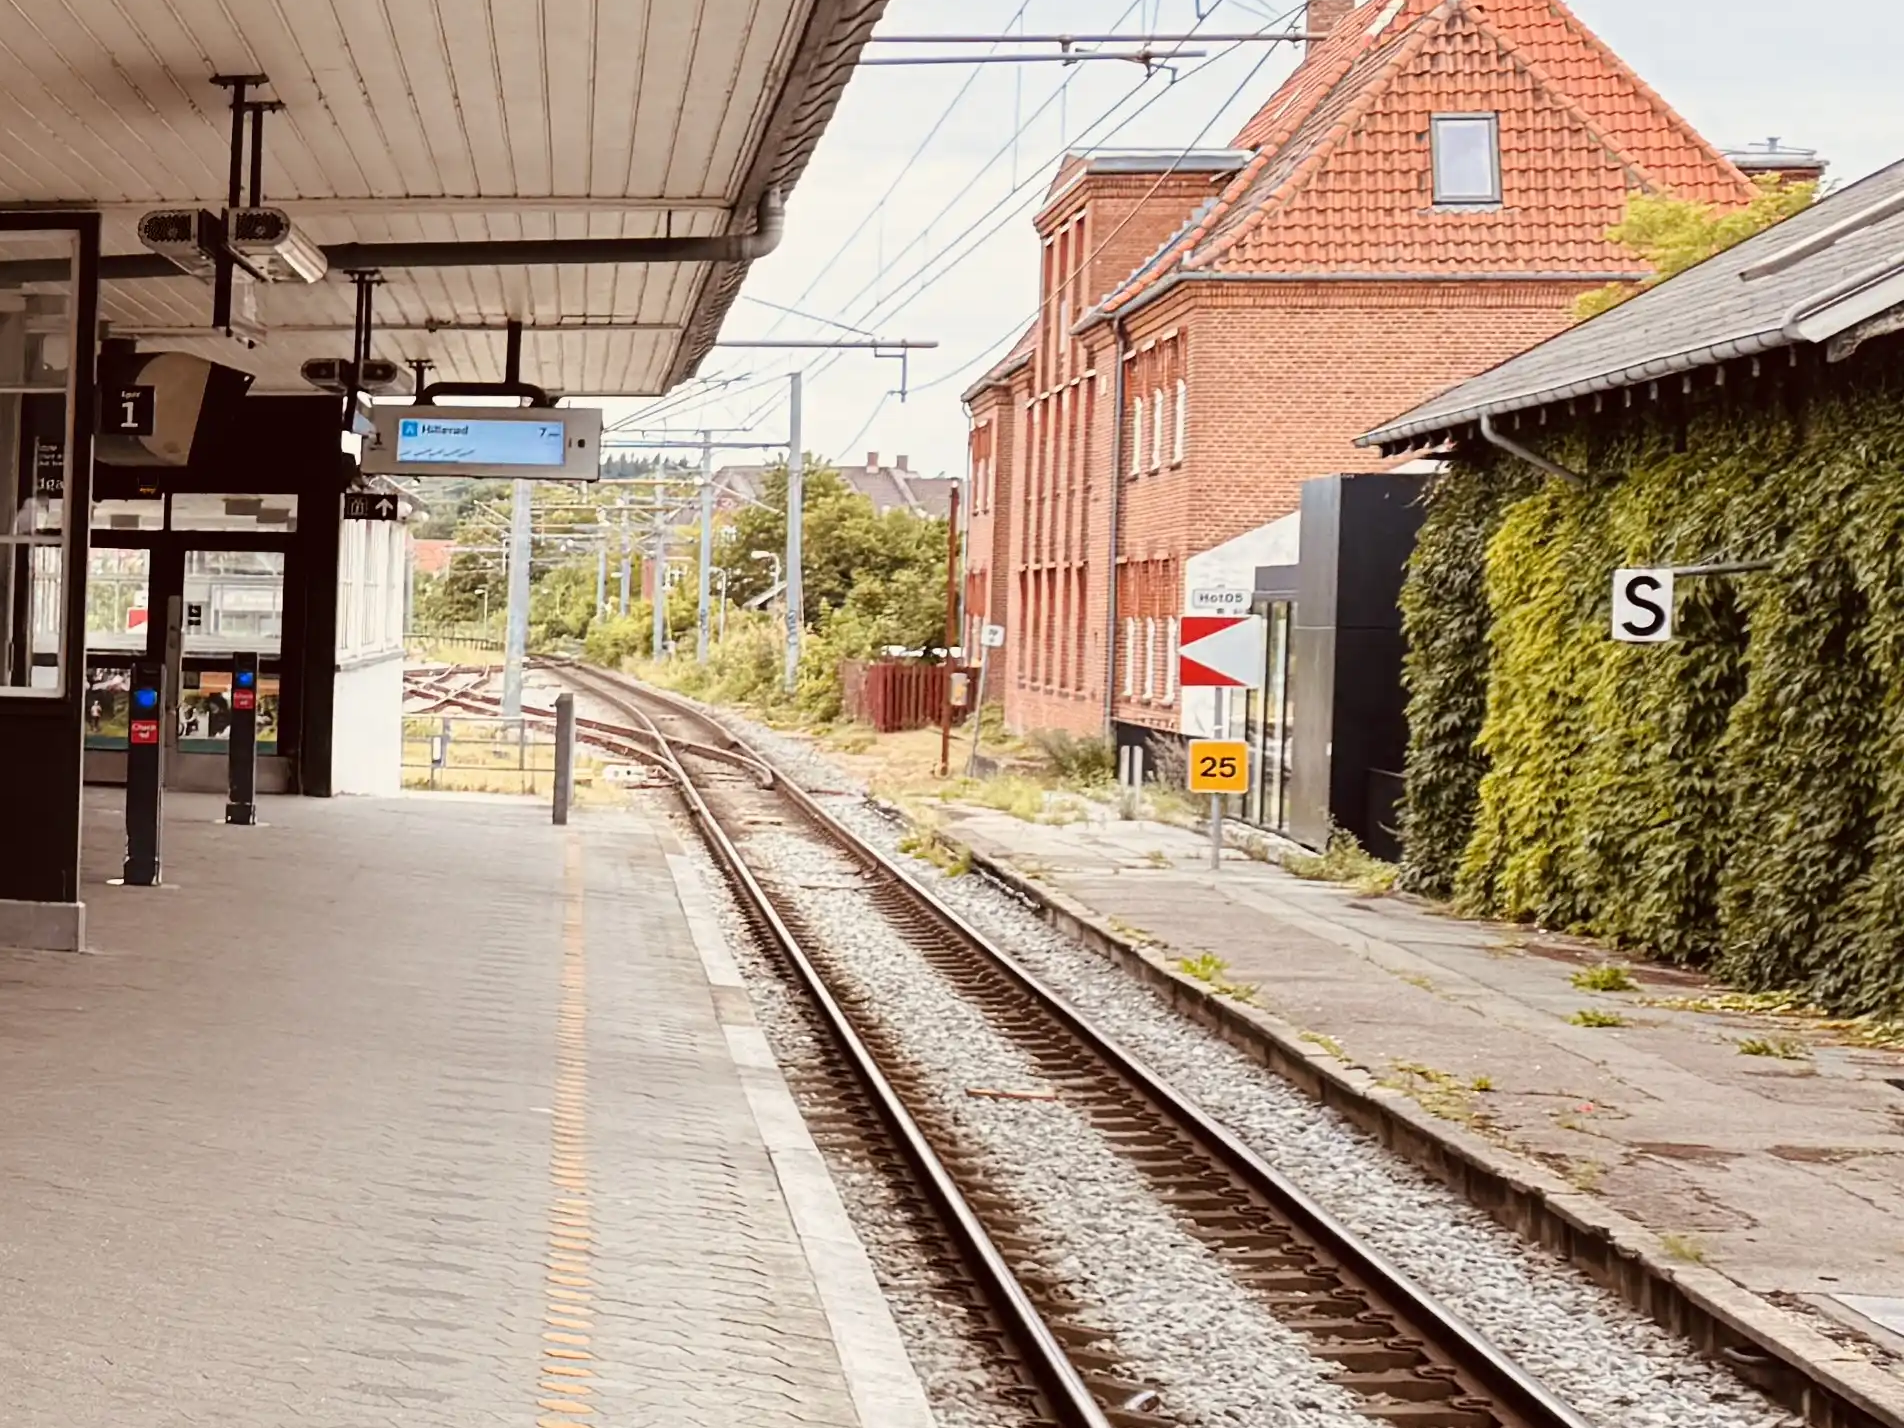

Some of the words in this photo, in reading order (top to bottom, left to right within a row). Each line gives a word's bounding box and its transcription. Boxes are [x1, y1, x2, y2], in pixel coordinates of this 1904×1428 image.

[120, 401, 139, 428] 1
[1622, 575, 1666, 637] S
[1200, 756, 1237, 778] 25
